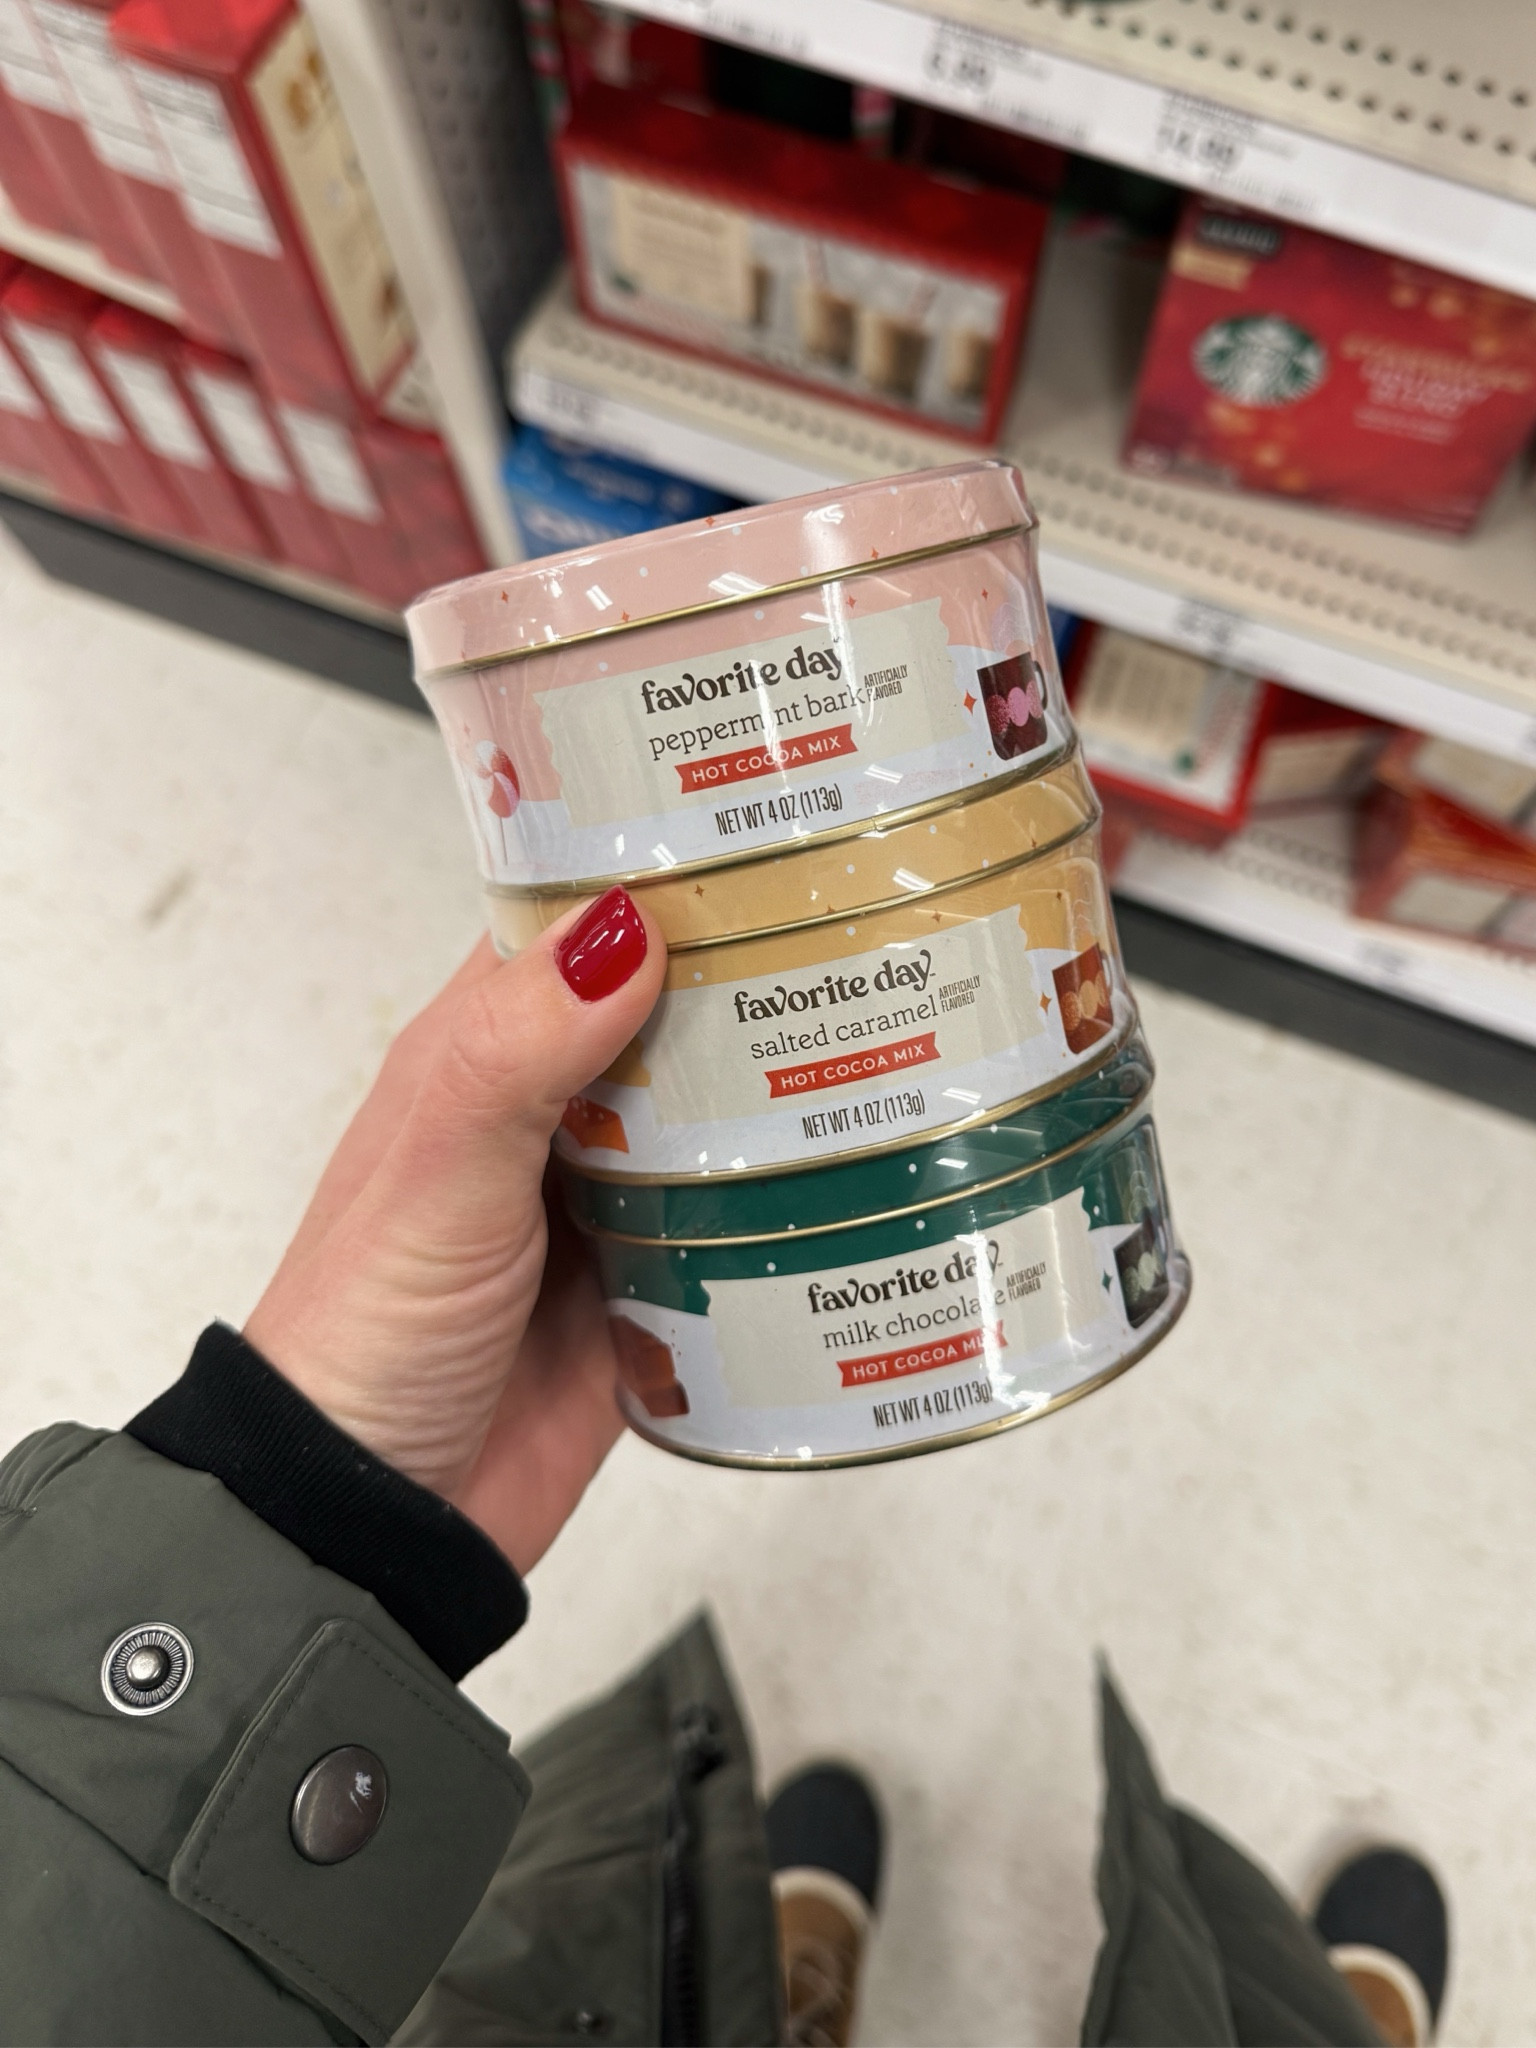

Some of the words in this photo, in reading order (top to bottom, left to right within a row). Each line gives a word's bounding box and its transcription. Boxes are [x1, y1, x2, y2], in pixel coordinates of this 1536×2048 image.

[641, 662, 781, 714] favorite
[786, 637, 843, 681] day
[864, 664, 908, 689] ARTIFICIALLY
[867, 681, 903, 702] FLAVORED
[649, 702, 803, 762] peppermnt
[804, 684, 866, 718] bark
[691, 763, 729, 783] HOT
[735, 746, 803, 773] COCOA
[808, 735, 842, 755] MIX
[714, 808, 742, 836] NET
[741, 801, 766, 830] WT
[768, 799, 779, 824] 4
[780, 794, 799, 821] OZ
[800, 783, 843, 819] (113g)
[734, 974, 869, 1023] favorite
[874, 949, 933, 991] day
[939, 975, 981, 1000] ARTIFICIALLY
[941, 991, 975, 1013] FLAVORED
[751, 1023, 830, 1059] salted
[835, 995, 938, 1042] caramel
[781, 1070, 817, 1089] HOT
[823, 1054, 889, 1080] COCOA
[893, 1043, 925, 1063] MIX
[802, 1113, 828, 1139] NET
[827, 1107, 851, 1134] WT
[853, 1106, 863, 1129] 4
[865, 1100, 885, 1125] OZ
[884, 1089, 926, 1124] (113g)
[808, 1268, 939, 1314] favorite
[1006, 1262, 1046, 1288] ARTIFICIALLY
[1008, 1278, 1042, 1301] FLAVORED
[823, 1320, 882, 1348] milk
[886, 1288, 1007, 1338] chocolae
[852, 1361, 889, 1380] HOT
[894, 1347, 958, 1371] COCOA
[873, 1402, 898, 1428] NET
[899, 1397, 921, 1423] WT
[923, 1394, 933, 1417] 4
[934, 1389, 953, 1414] OZ
[953, 1376, 993, 1411] (113g)
